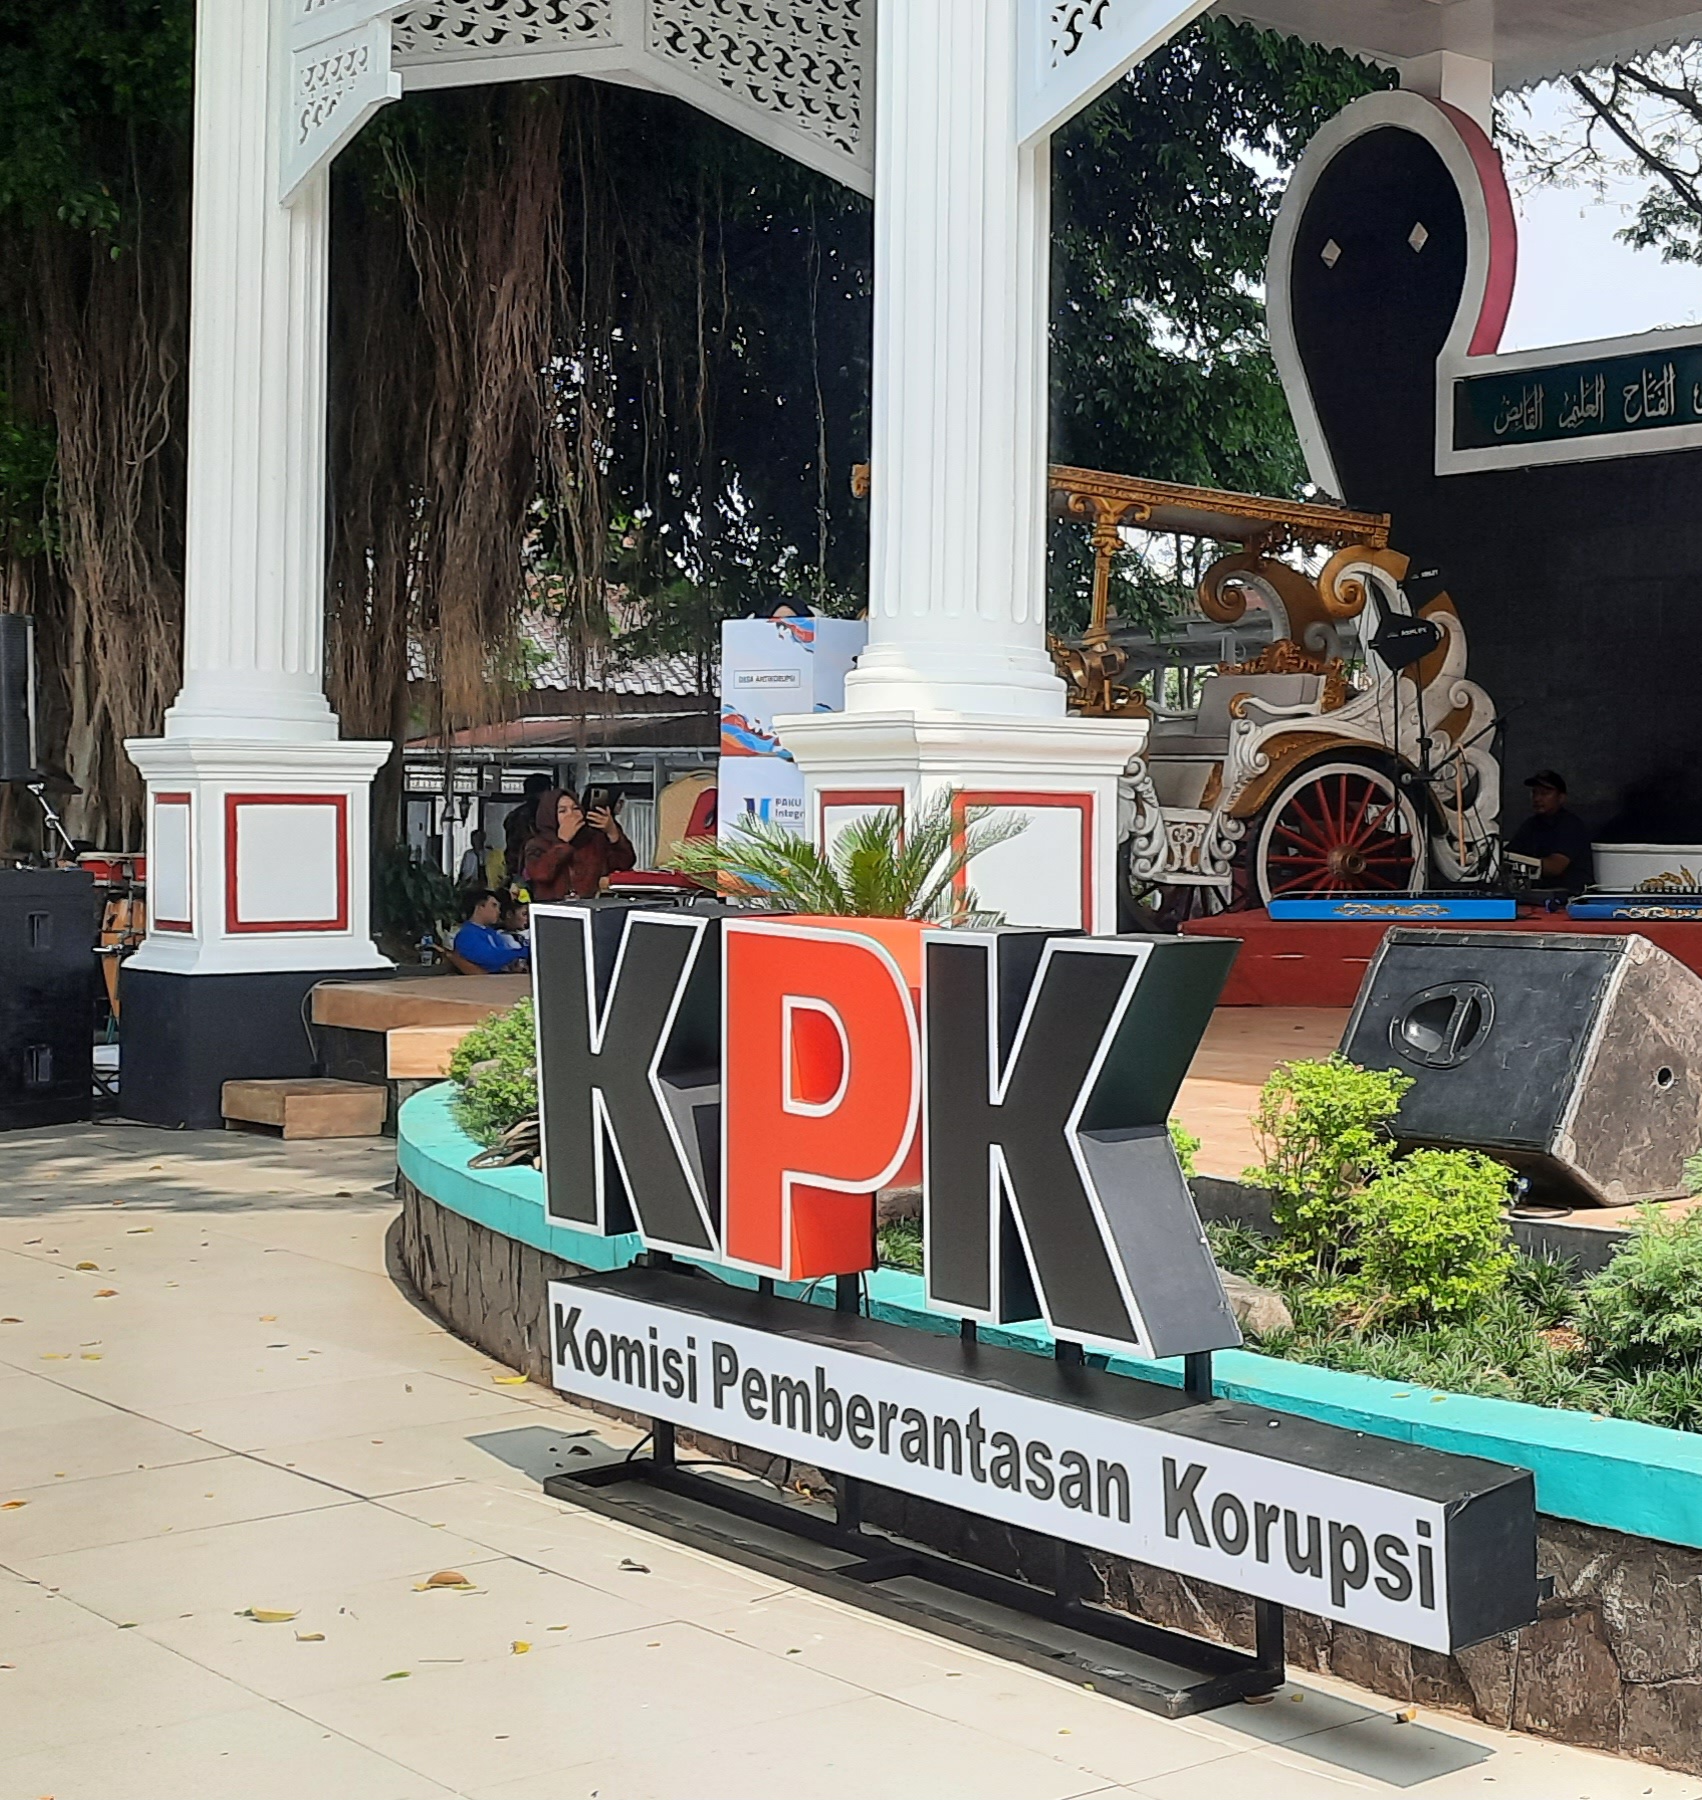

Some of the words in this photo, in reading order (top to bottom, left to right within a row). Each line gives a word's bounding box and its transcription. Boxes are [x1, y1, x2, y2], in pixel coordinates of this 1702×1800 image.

[775, 797, 802, 807] PAKU
[530, 903, 1154, 1358] KPK
[552, 1302, 700, 1405] Komisi
[710, 1338, 1133, 1525] Pemberantasan
[1160, 1454, 1438, 1611] Korupsi
